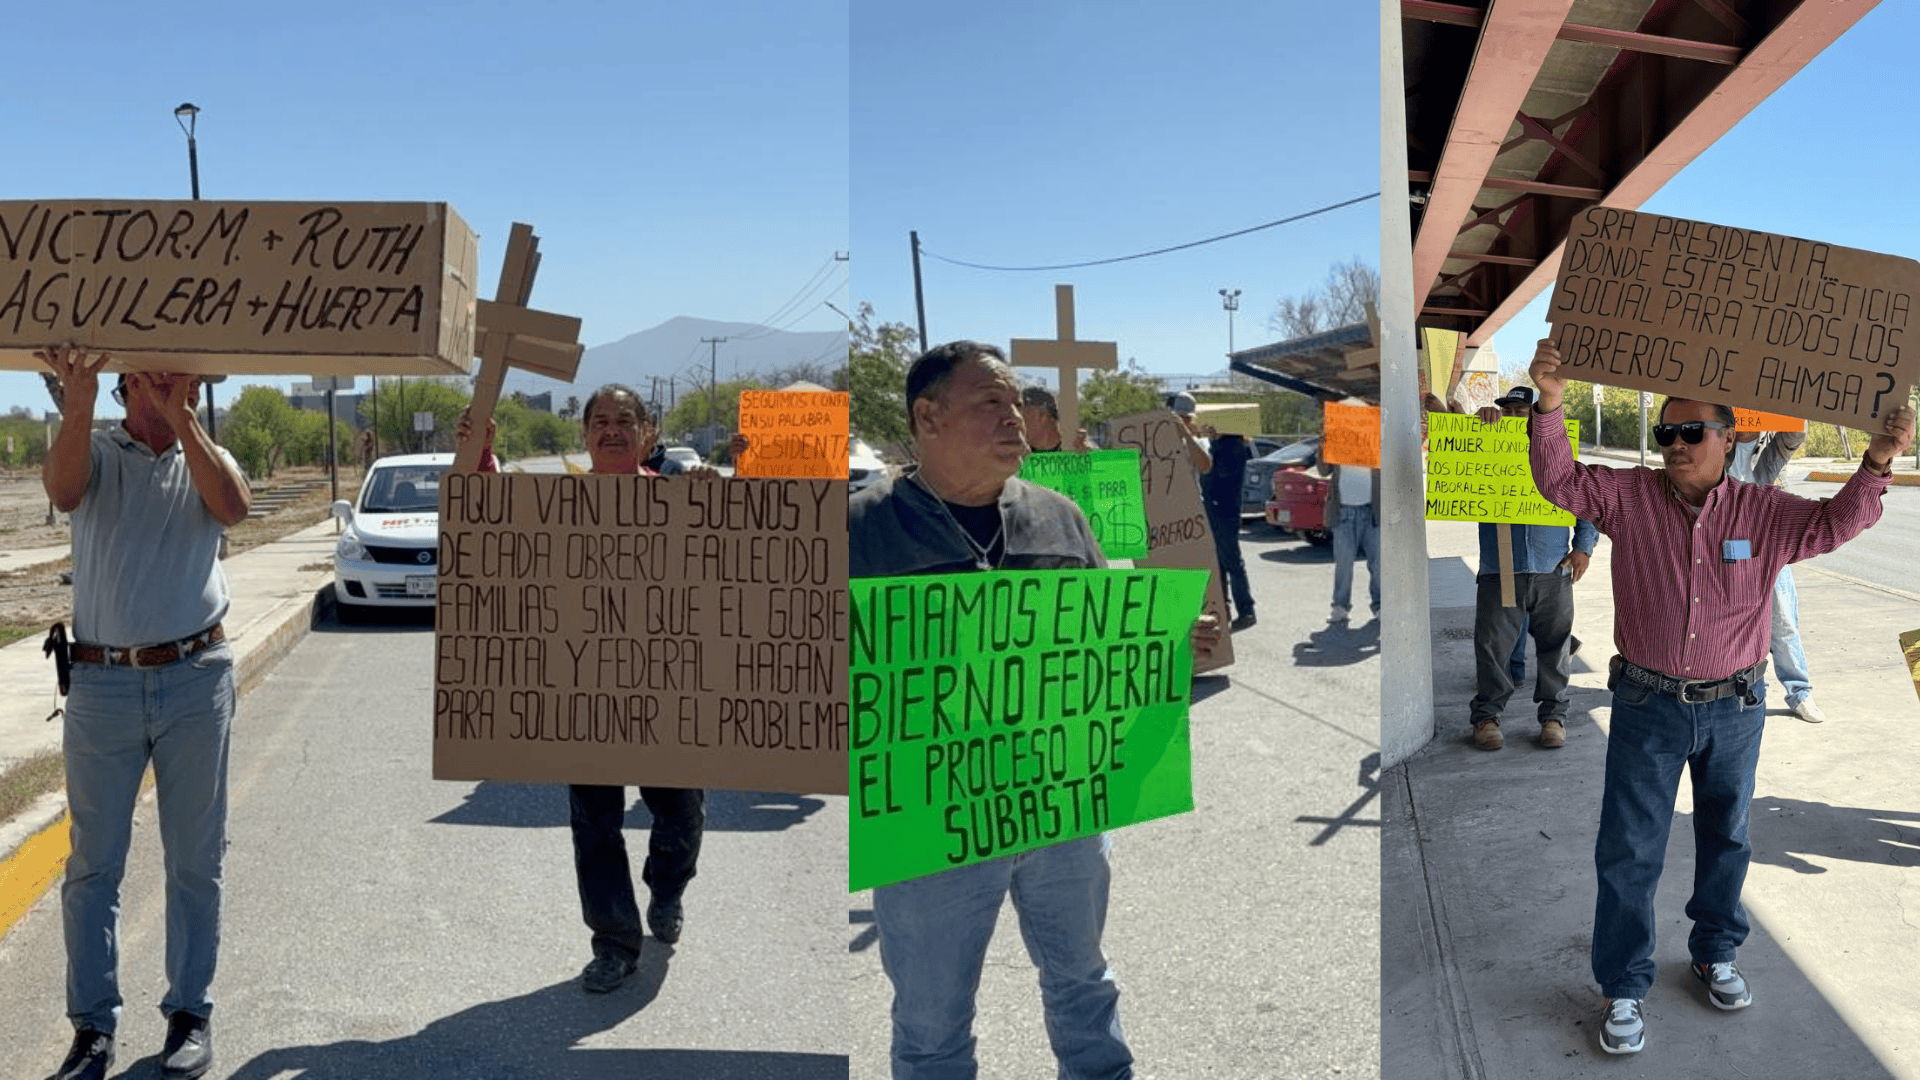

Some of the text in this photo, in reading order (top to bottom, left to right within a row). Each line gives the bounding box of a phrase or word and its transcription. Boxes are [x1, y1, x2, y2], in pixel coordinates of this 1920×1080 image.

[292, 207, 425, 276] RUTH
[1580, 206, 1638, 241] SRA
[1568, 238, 1911, 327] DONDE ESTA SU JUSTICIA
[1558, 274, 1905, 369] SOCIAL PARA TODOS LOS
[1558, 322, 1688, 383] OBREROS
[1699, 346, 1740, 392] DE
[778, 411, 832, 428] PALABRA
[1734, 416, 1762, 428] RERA
[1427, 459, 1527, 477] LOS DERECHOS
[1427, 480, 1497, 496] LABORALES
[446, 474, 514, 526] AQUI
[535, 474, 601, 527] VAN
[616, 476, 670, 528] LOS
[809, 478, 832, 533] Y
[1148, 513, 1206, 551] BREROS
[1425, 498, 1488, 517] MUJERES
[1493, 501, 1513, 518] DE
[438, 530, 830, 586] DE CADA OBRERO FALLECIDO
[438, 582, 846, 642] FAMILIAS SIN QUE EL GOBIE
[1054, 576, 1111, 646] EN
[1119, 575, 1168, 639] EL
[437, 634, 834, 696] ESTATAL Y FEDERAL HAGAN
[852, 640, 1183, 750] BIERNO FEDERAL
[435, 688, 849, 752] PARA SOLUCIONAR EL PROBLEMA
[858, 716, 1126, 819] EL PROCESO DE
[944, 773, 1110, 865] SUBASTA
